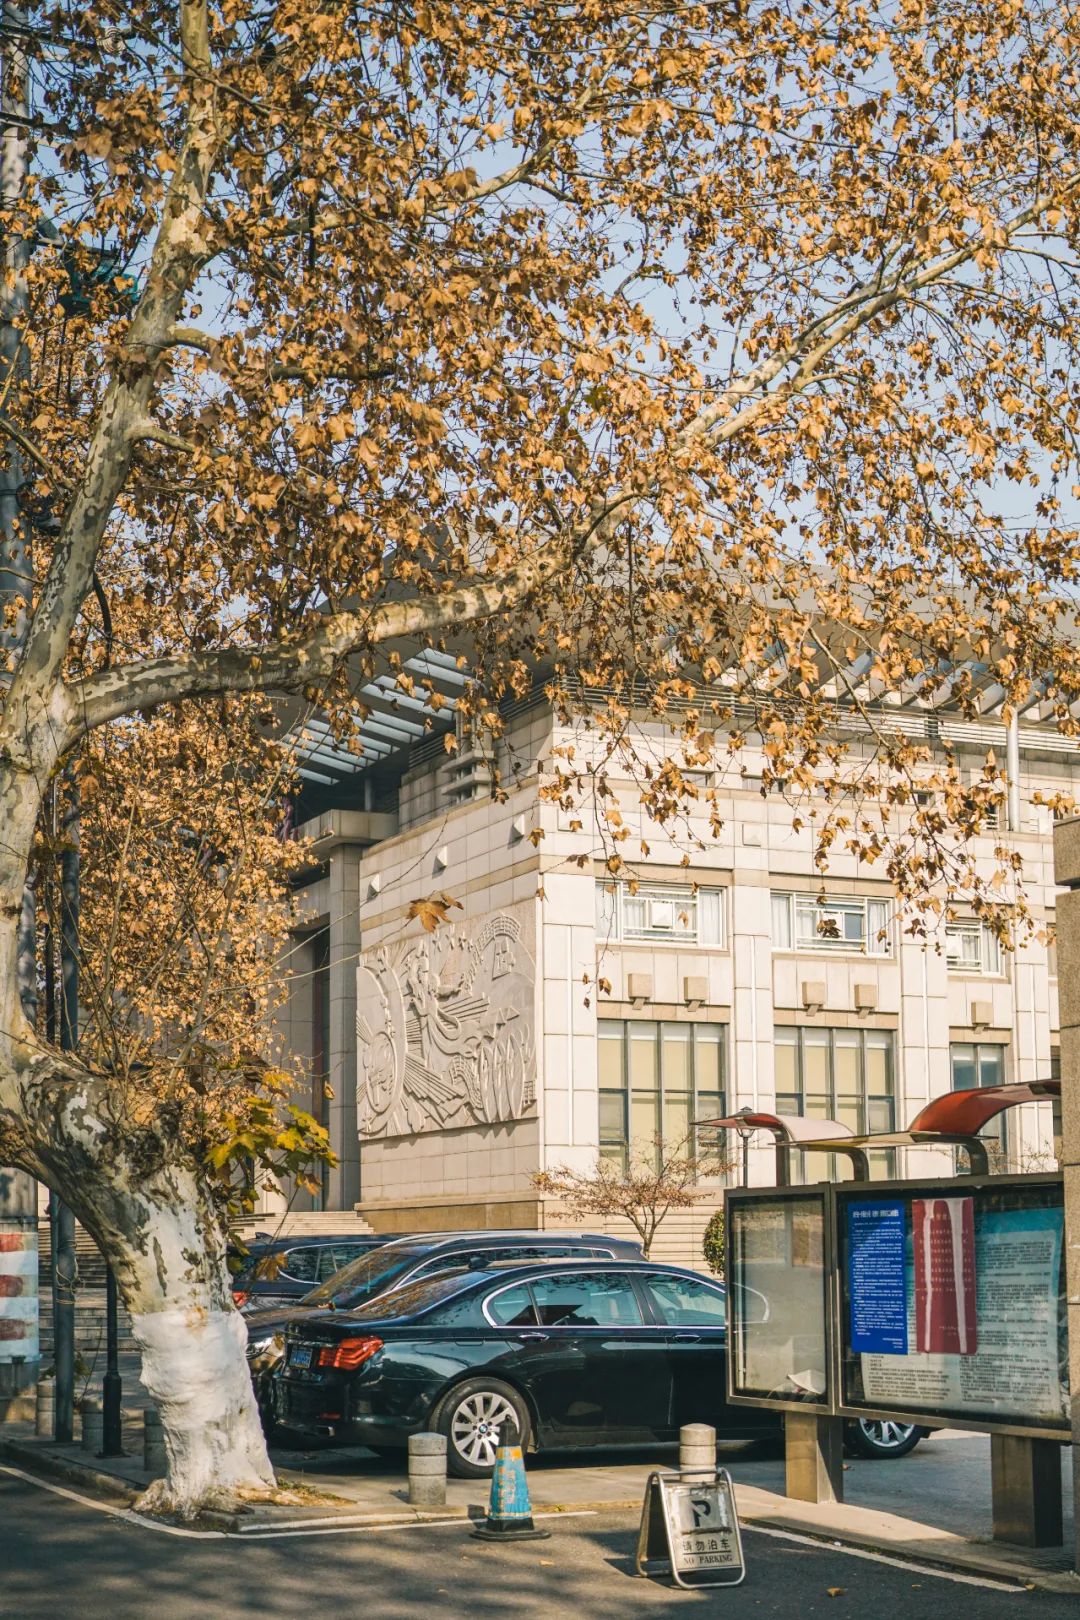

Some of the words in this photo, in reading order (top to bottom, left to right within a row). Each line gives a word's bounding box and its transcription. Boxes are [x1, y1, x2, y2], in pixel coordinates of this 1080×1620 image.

[683, 1539, 730, 1551] 请勿泊车
[699, 1554, 732, 1564] PARKING
